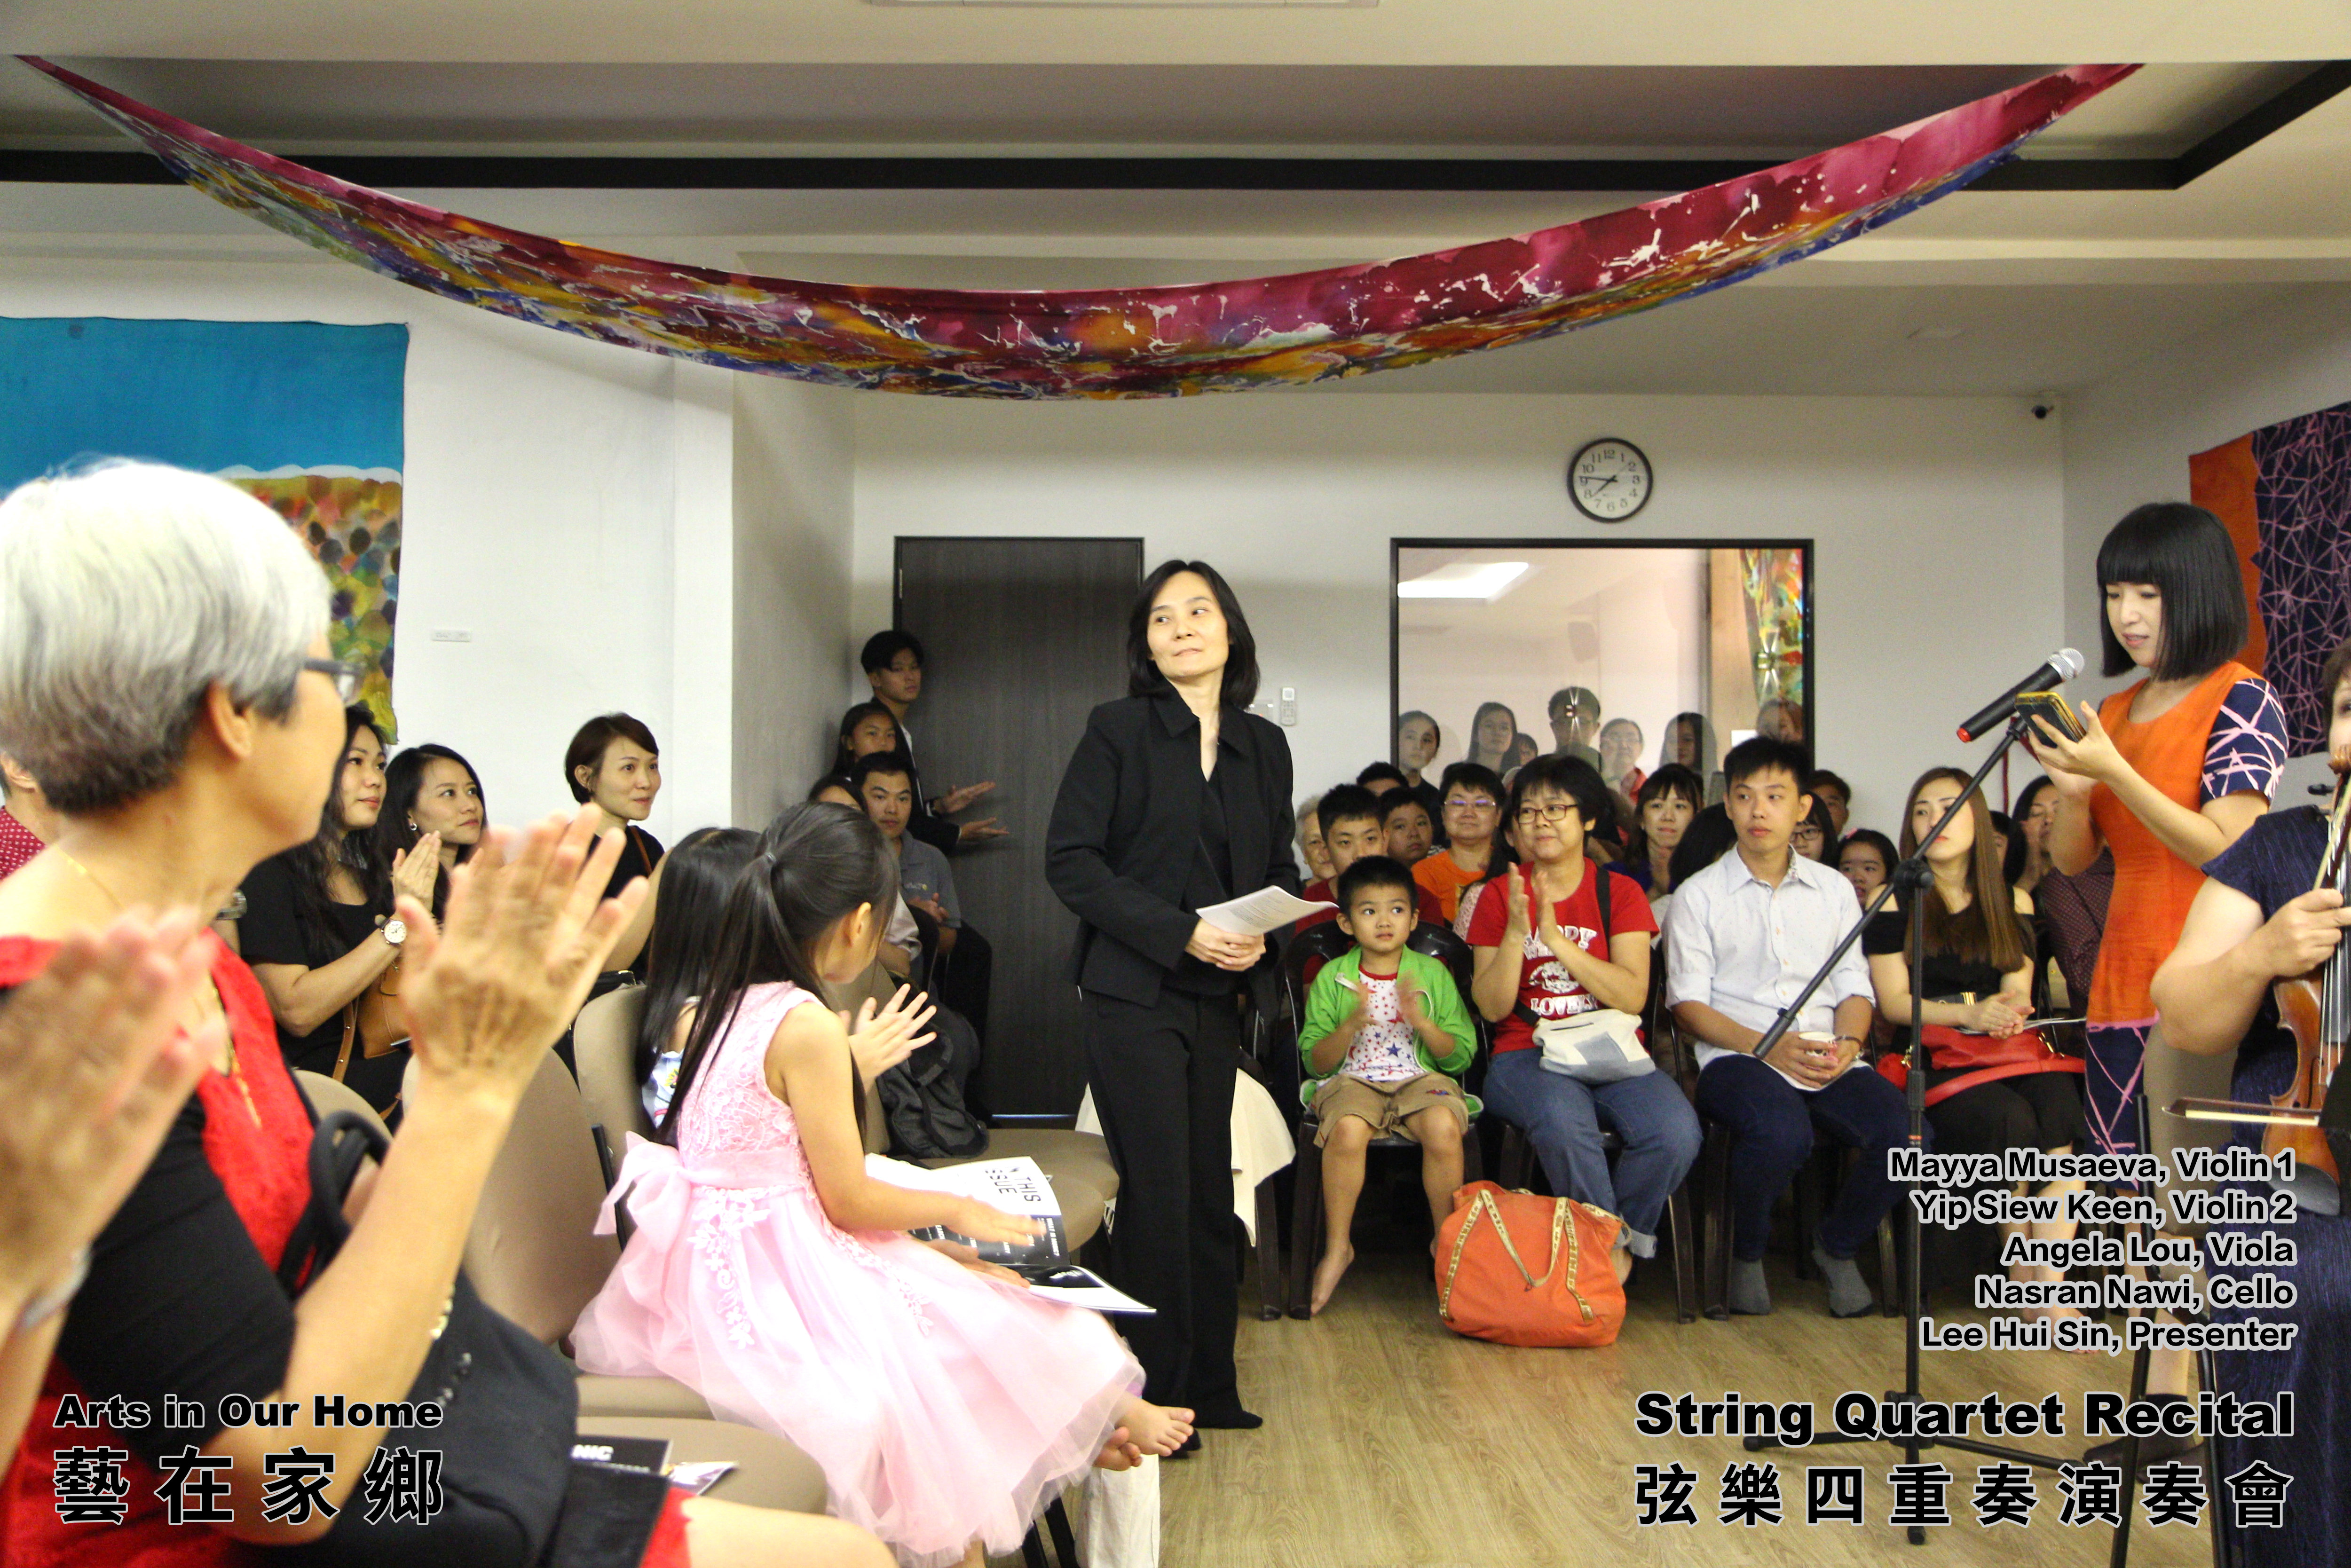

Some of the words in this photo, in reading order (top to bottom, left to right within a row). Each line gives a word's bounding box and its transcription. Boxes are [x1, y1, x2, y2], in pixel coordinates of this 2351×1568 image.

[1591, 453, 1601, 464] 11
[1603, 449, 1616, 459] 12
[1620, 452, 1625, 462] 1
[1582, 464, 1594, 473] 10
[1628, 462, 1636, 472] 2
[1632, 475, 1641, 485] 3
[1628, 489, 1637, 497] 4
[1594, 498, 1602, 508] 7
[1606, 501, 1615, 512] 6
[1620, 498, 1628, 508] 5
